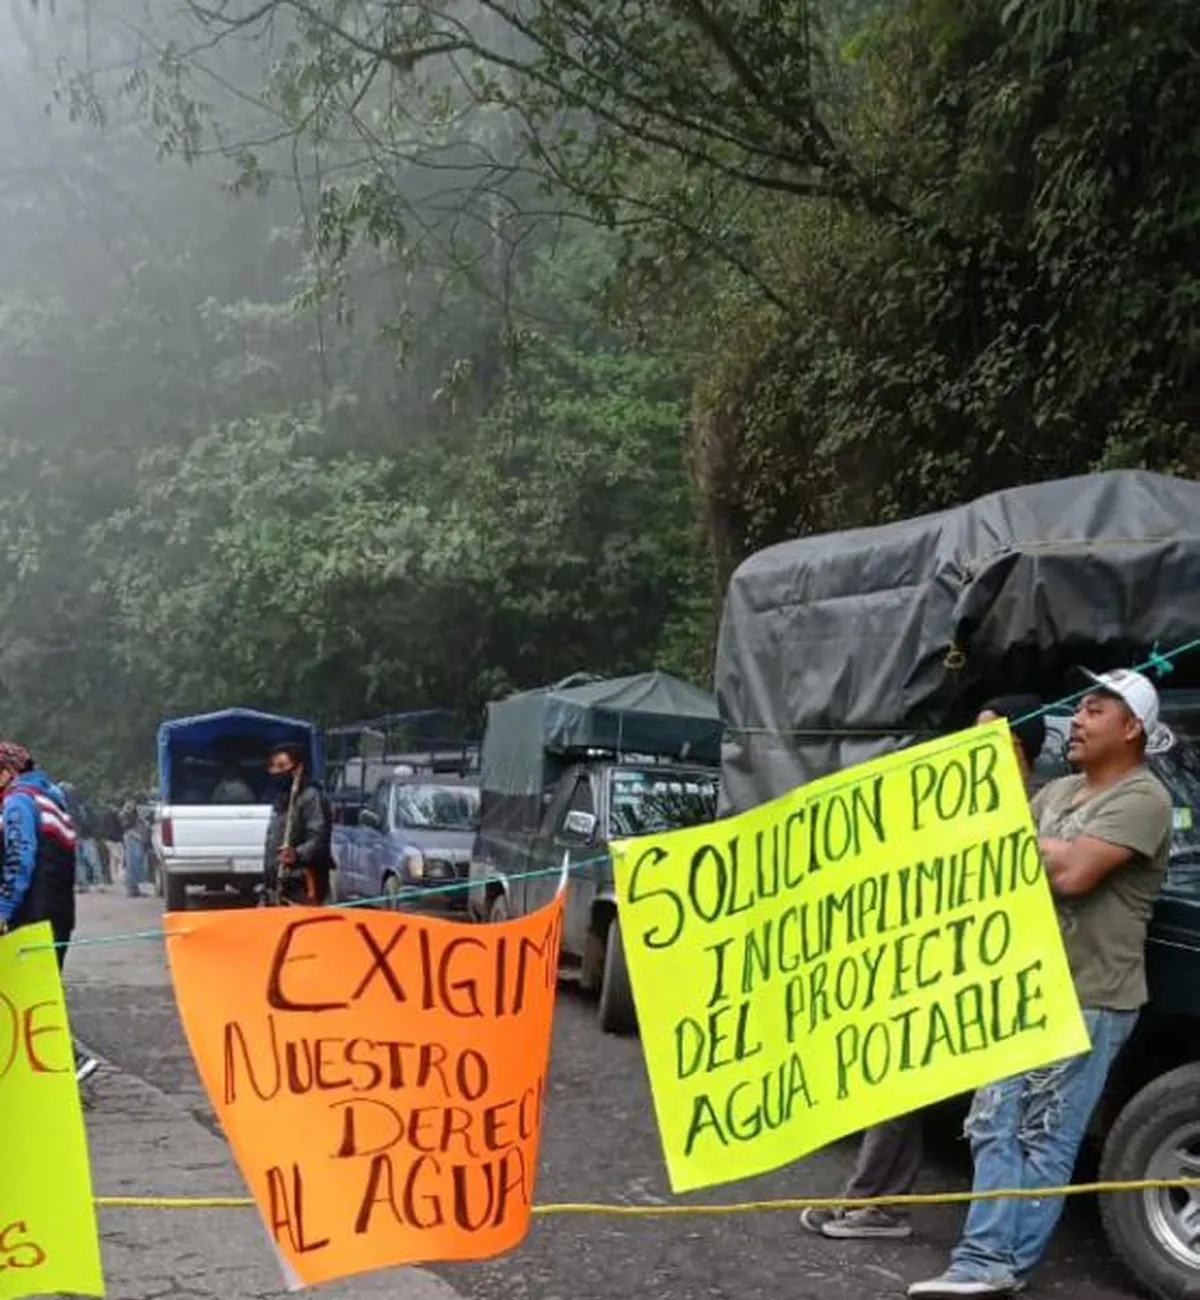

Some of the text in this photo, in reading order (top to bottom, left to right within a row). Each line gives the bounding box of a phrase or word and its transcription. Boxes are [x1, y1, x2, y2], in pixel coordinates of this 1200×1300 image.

[628, 742, 1001, 949] SOLUCION POR
[703, 826, 1043, 1009] INCUMPLIMIENTO
[224, 1013, 489, 1105] NUESTRO
[674, 910, 1011, 1081] DEL PROYECTO
[836, 960, 1048, 1101] POTABLE
[265, 1144, 530, 1253] AL AGUA
